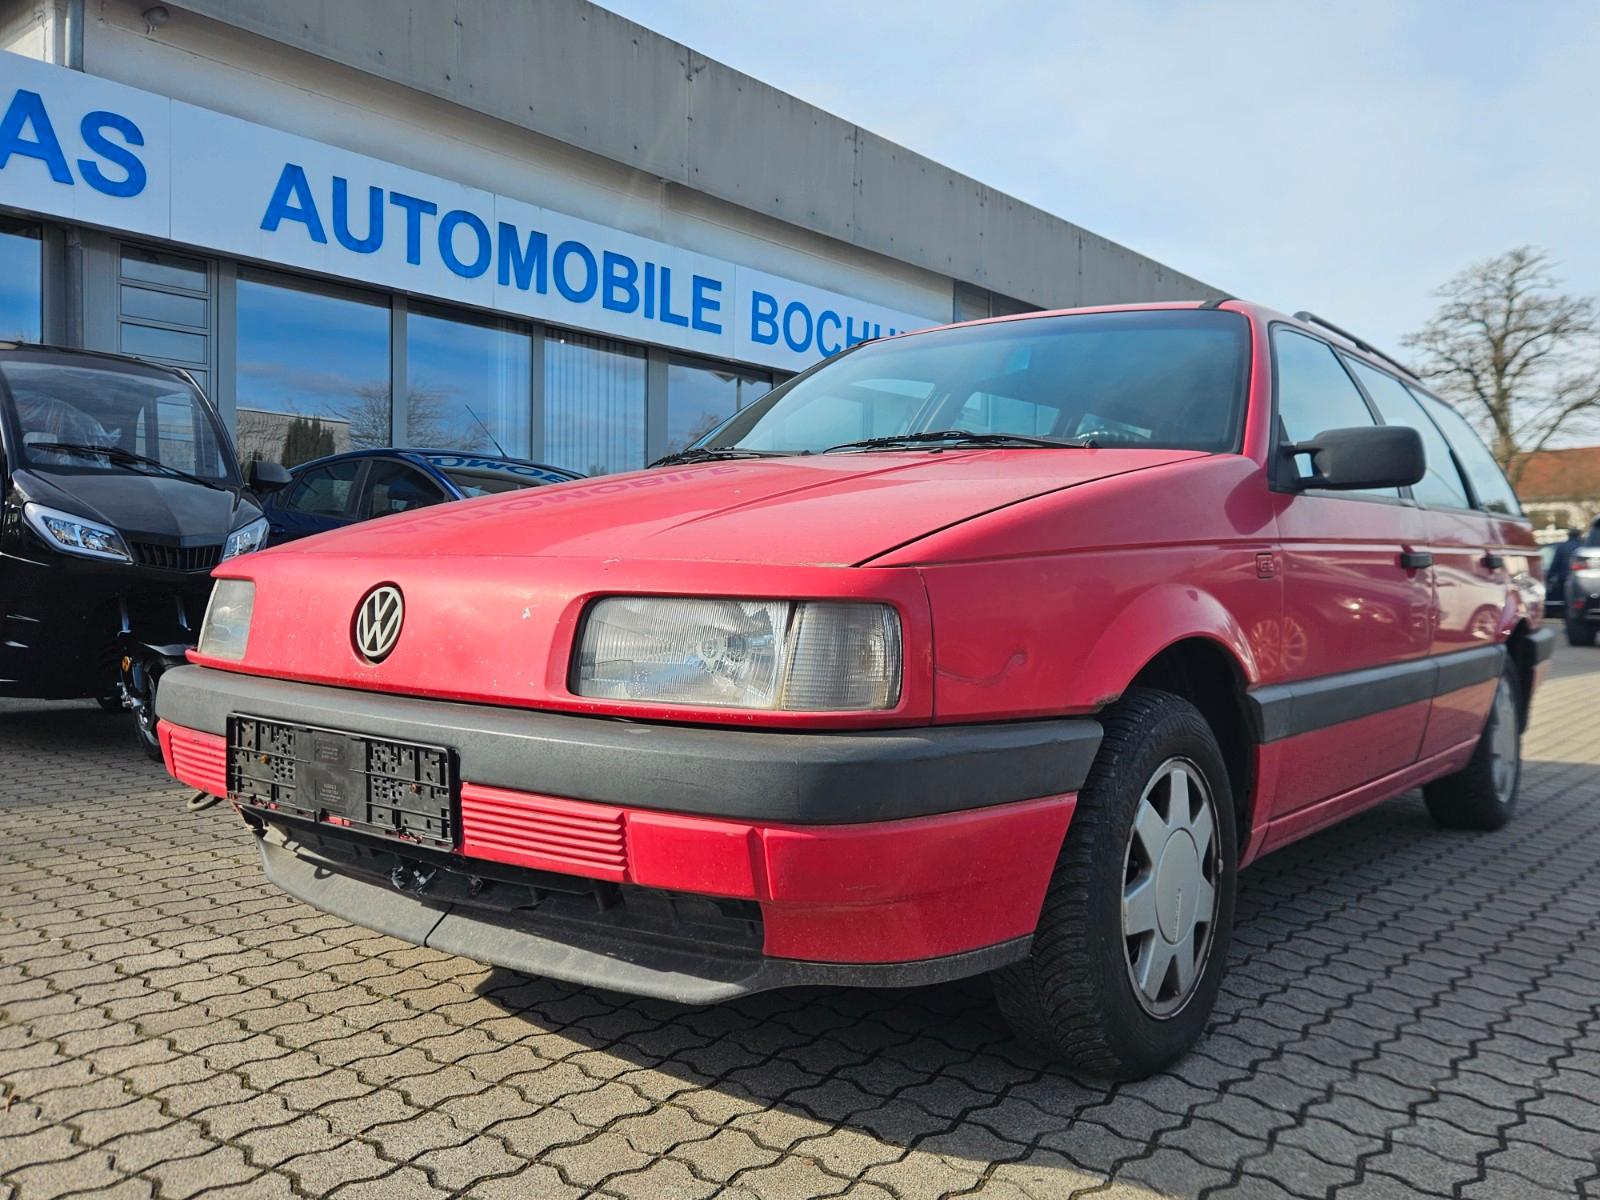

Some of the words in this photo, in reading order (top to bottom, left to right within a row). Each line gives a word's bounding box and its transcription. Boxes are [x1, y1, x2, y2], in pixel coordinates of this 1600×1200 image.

[0, 88, 148, 198] AS
[260, 162, 723, 335] AUTOMOBILE
[356, 586, 403, 657] VW
